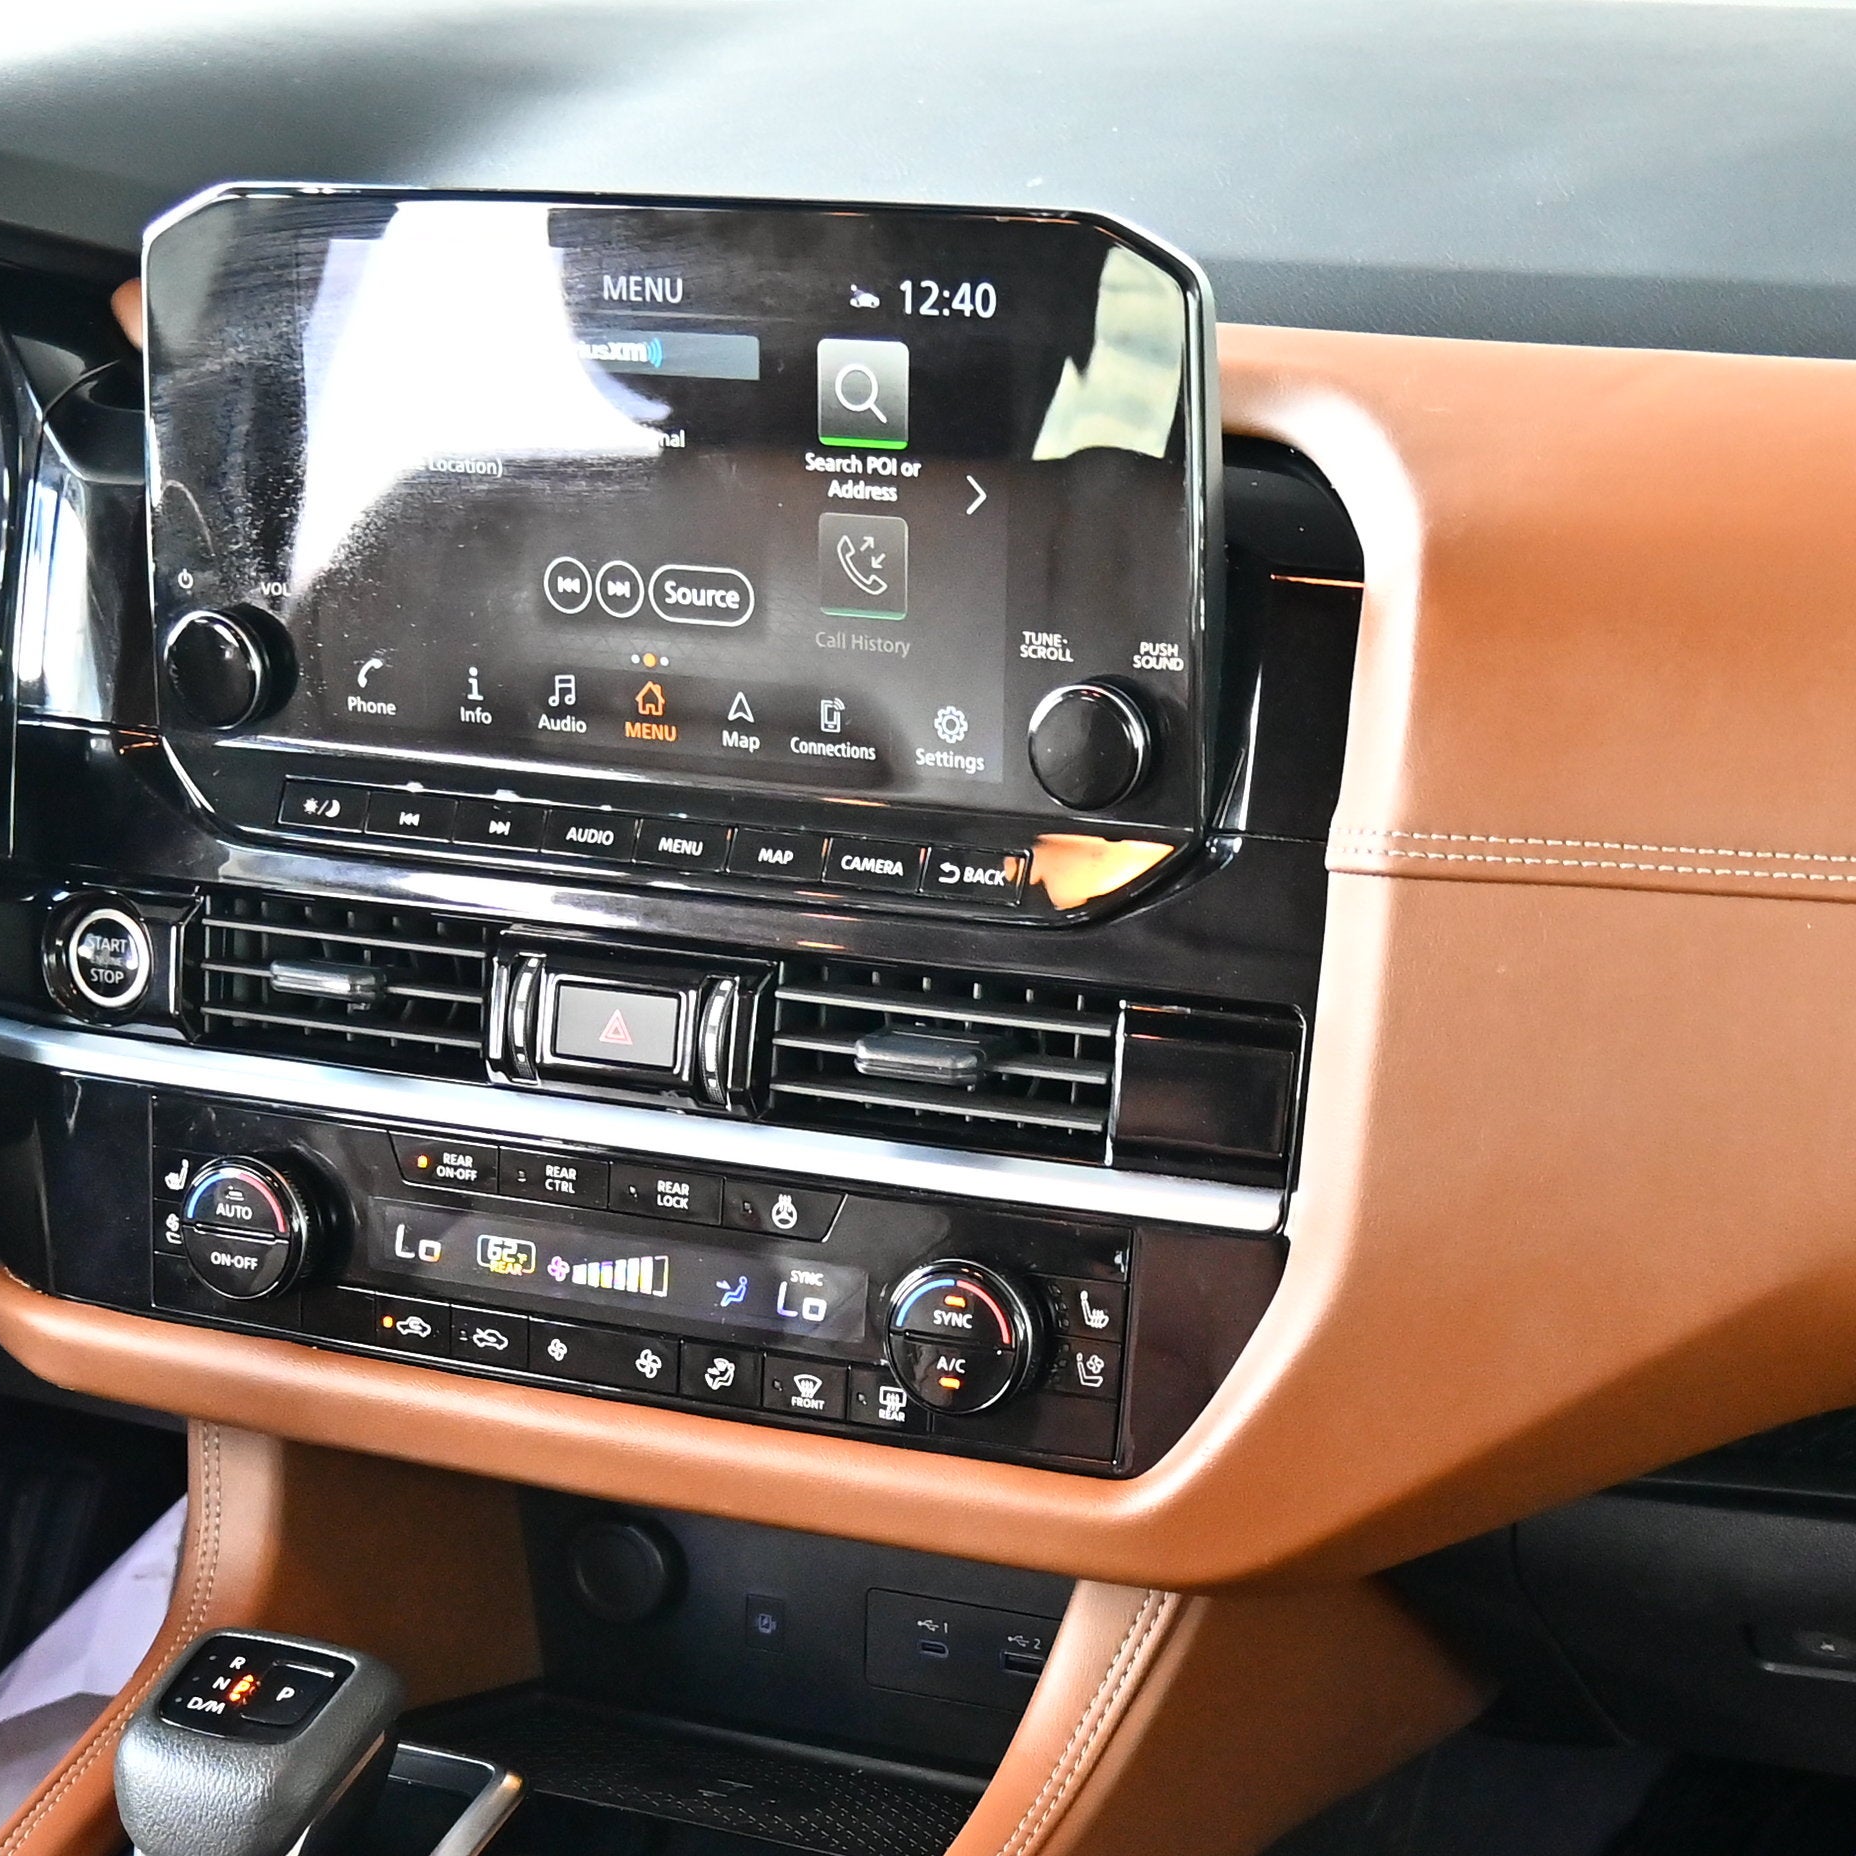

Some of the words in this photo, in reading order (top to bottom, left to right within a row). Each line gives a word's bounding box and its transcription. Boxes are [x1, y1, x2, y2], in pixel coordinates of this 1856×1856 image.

[602, 274, 684, 304] MENU
[900, 279, 997, 319] 12:40
[804, 452, 863, 475] Search
[866, 456, 897, 477] POI
[901, 462, 922, 477] or
[827, 479, 898, 503] Address
[260, 581, 291, 597] VOL
[664, 580, 741, 610] Source
[815, 631, 847, 650] Call
[850, 634, 911, 658] History
[1020, 644, 1074, 663] SCROLL
[1139, 642, 1180, 658] PUSH
[1132, 655, 1185, 672] SOUND
[347, 697, 398, 717] Phone
[460, 707, 494, 726] Info
[538, 714, 588, 735] Audio
[625, 722, 677, 742] MENU
[722, 731, 761, 753] Map
[790, 737, 877, 762] Connections
[915, 748, 986, 775] Settings
[565, 825, 615, 847] AUDIO
[658, 836, 704, 858] MENU
[758, 846, 794, 867] MAP
[840, 853, 905, 878] CAMERA
[962, 865, 1007, 887] BACK
[87, 934, 127, 953] START
[90, 968, 124, 984] STOP
[443, 1153, 473, 1168] REAR
[545, 1164, 576, 1181] REAR
[545, 1179, 576, 1194] CTRL
[657, 1180, 690, 1197] REAR
[215, 1202, 253, 1221] AUTO
[657, 1195, 689, 1210] LOCK
[790, 1270, 824, 1287] SYNC
[933, 1309, 973, 1329] SYNC
[936, 1355, 966, 1374] A/C
[791, 1396, 825, 1410] FRONT
[878, 1409, 906, 1423] REAR
[1033, 1638, 1041, 1650] 2
[229, 1656, 246, 1670] R
[212, 1676, 231, 1691] N
[275, 1686, 295, 1702] P
[187, 1696, 226, 1715] D/M
